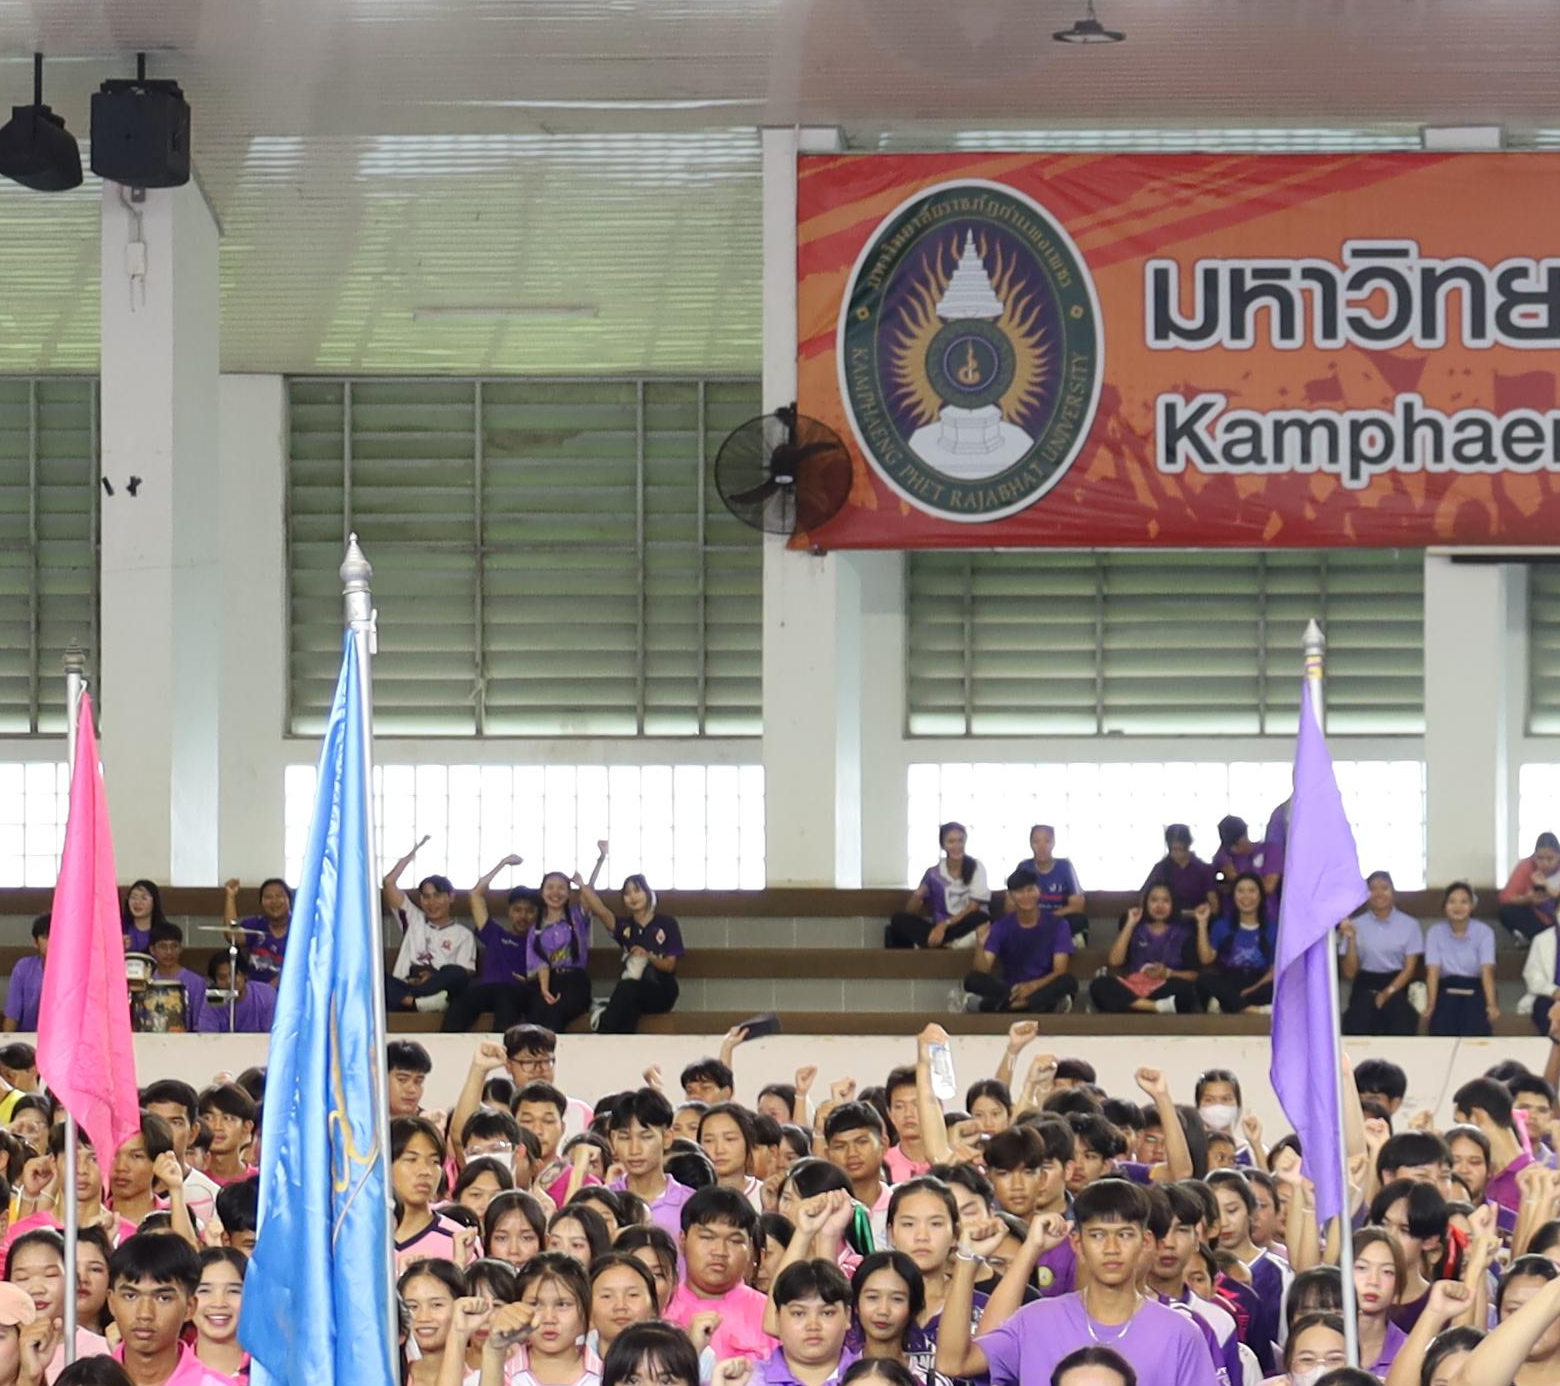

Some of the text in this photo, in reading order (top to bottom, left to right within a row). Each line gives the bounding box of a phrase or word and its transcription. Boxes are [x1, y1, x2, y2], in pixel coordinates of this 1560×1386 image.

[851, 348, 1090, 512] KAMPHAENG PHET RAJABHAT UNIVERSITY
